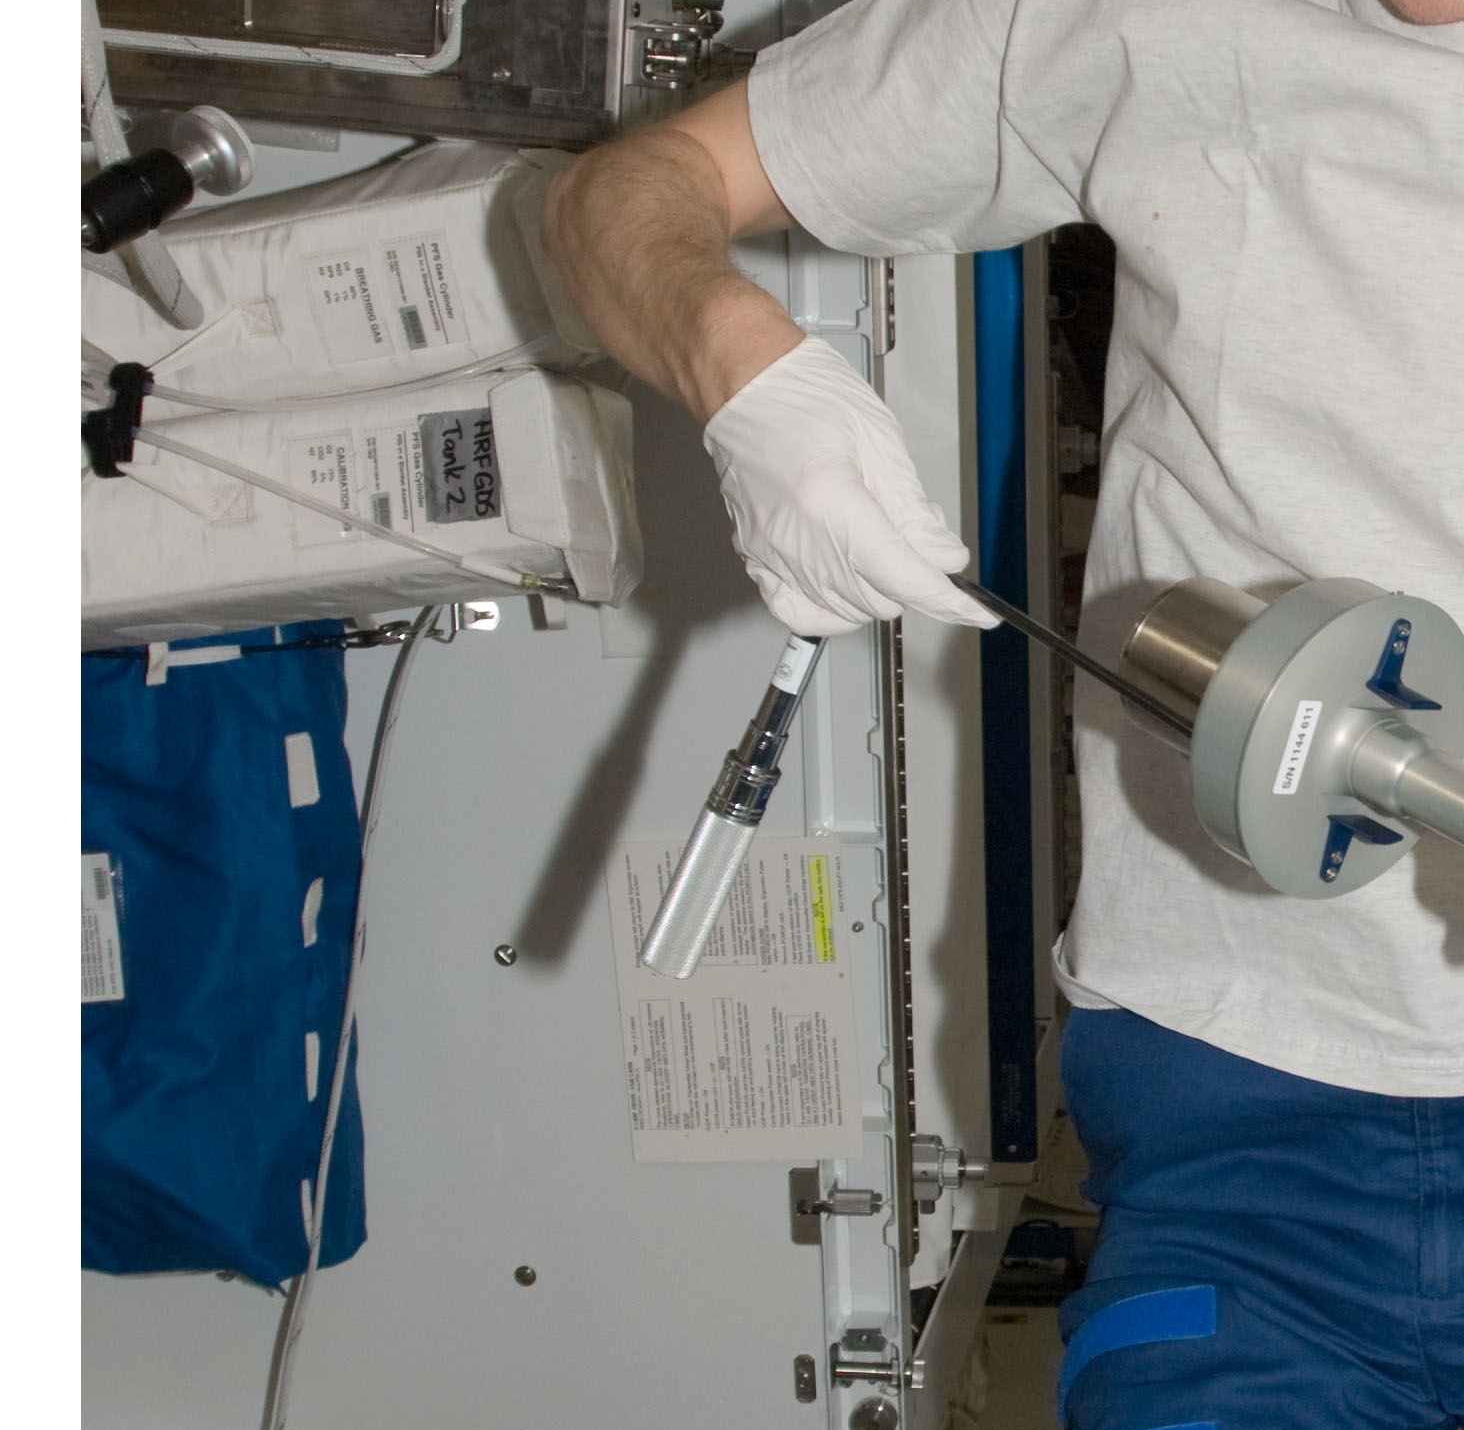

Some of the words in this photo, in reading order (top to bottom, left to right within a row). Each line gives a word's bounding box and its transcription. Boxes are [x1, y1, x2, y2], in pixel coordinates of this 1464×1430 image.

[430, 242, 442, 261] PFS
[434, 262, 447, 282] Gas
[355, 267, 378, 322] BREATHING
[370, 323, 383, 344] GAS
[438, 283, 455, 320] Cylinder
[410, 431, 421, 450] PFS
[440, 418, 467, 484] Tank
[473, 418, 491, 469] HRF
[336, 446, 350, 510] CALIBRATION
[412, 451, 422, 470] Gas
[398, 487, 411, 520] Assembly
[413, 471, 425, 509] Cylinder
[444, 487, 468, 514] 2
[1282, 766, 1296, 789] S/N
[1290, 733, 1306, 763] 1144
[1300, 707, 1314, 729] 611
